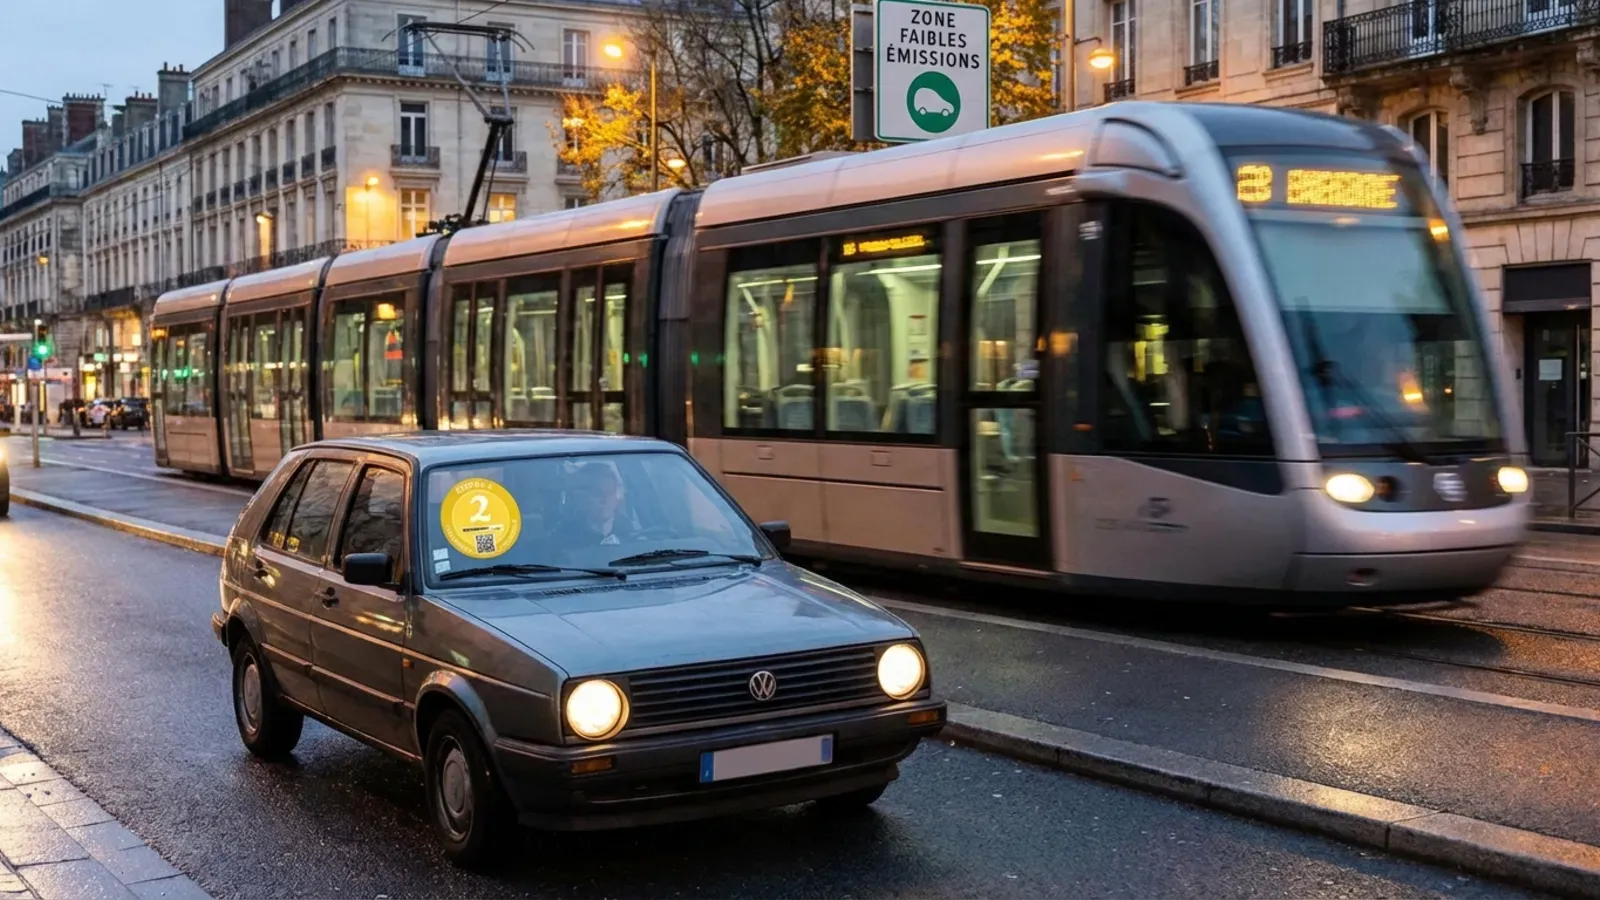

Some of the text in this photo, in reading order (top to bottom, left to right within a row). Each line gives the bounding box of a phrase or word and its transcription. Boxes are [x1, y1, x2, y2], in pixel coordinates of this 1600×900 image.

[911, 9, 956, 28] ZONE
[900, 28, 967, 48] FAIBLES
[886, 43, 980, 69] ÉMISSIONS
[469, 494, 492, 523] 2
